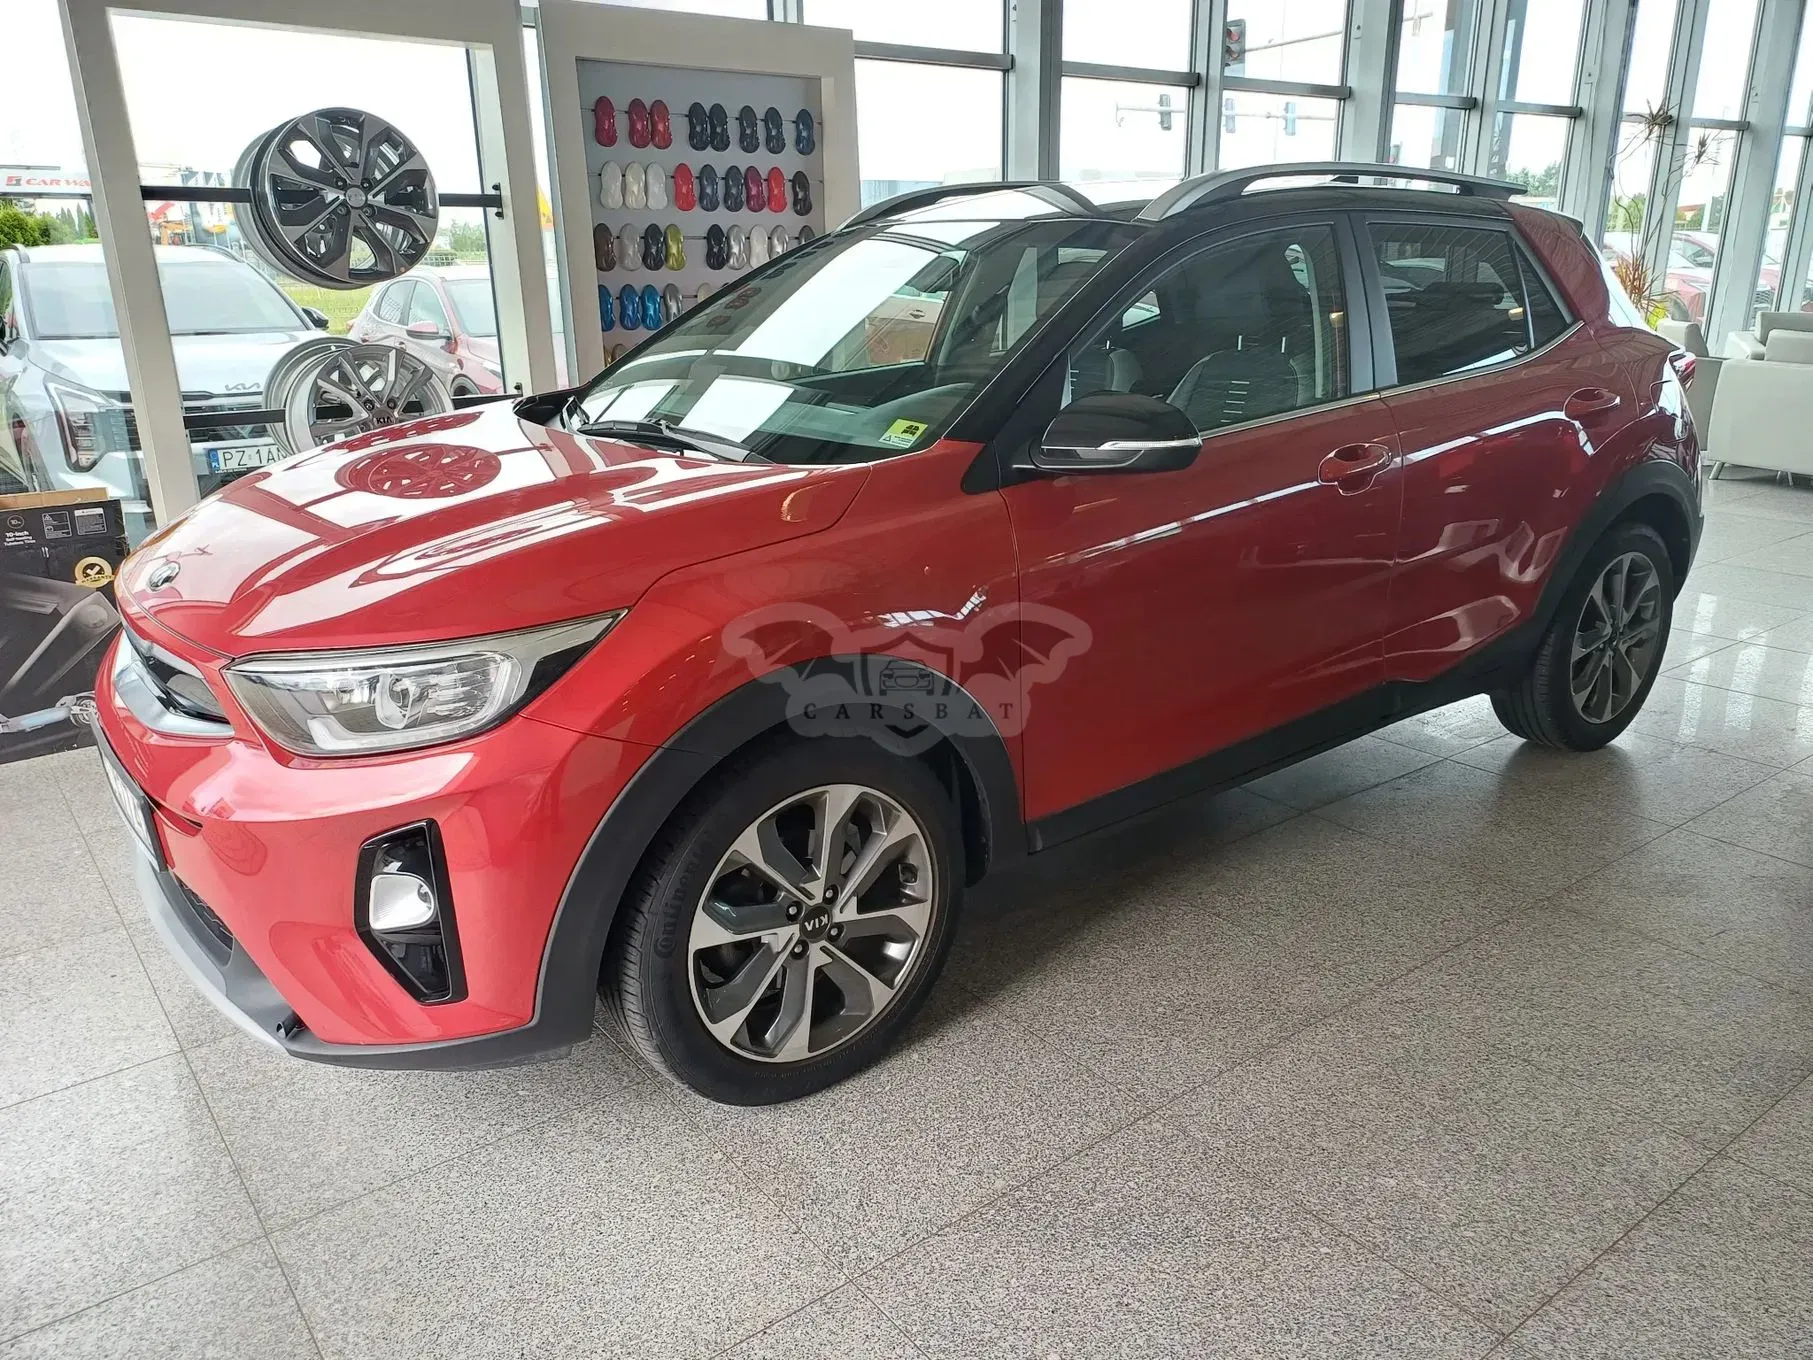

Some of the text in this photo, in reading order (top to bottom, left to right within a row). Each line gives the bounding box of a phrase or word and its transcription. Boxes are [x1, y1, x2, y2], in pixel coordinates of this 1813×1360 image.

[26, 178, 61, 186] CAR
[375, 417, 393, 425] KIA
[222, 450, 248, 468] PZ
[803, 913, 829, 932] KIA
